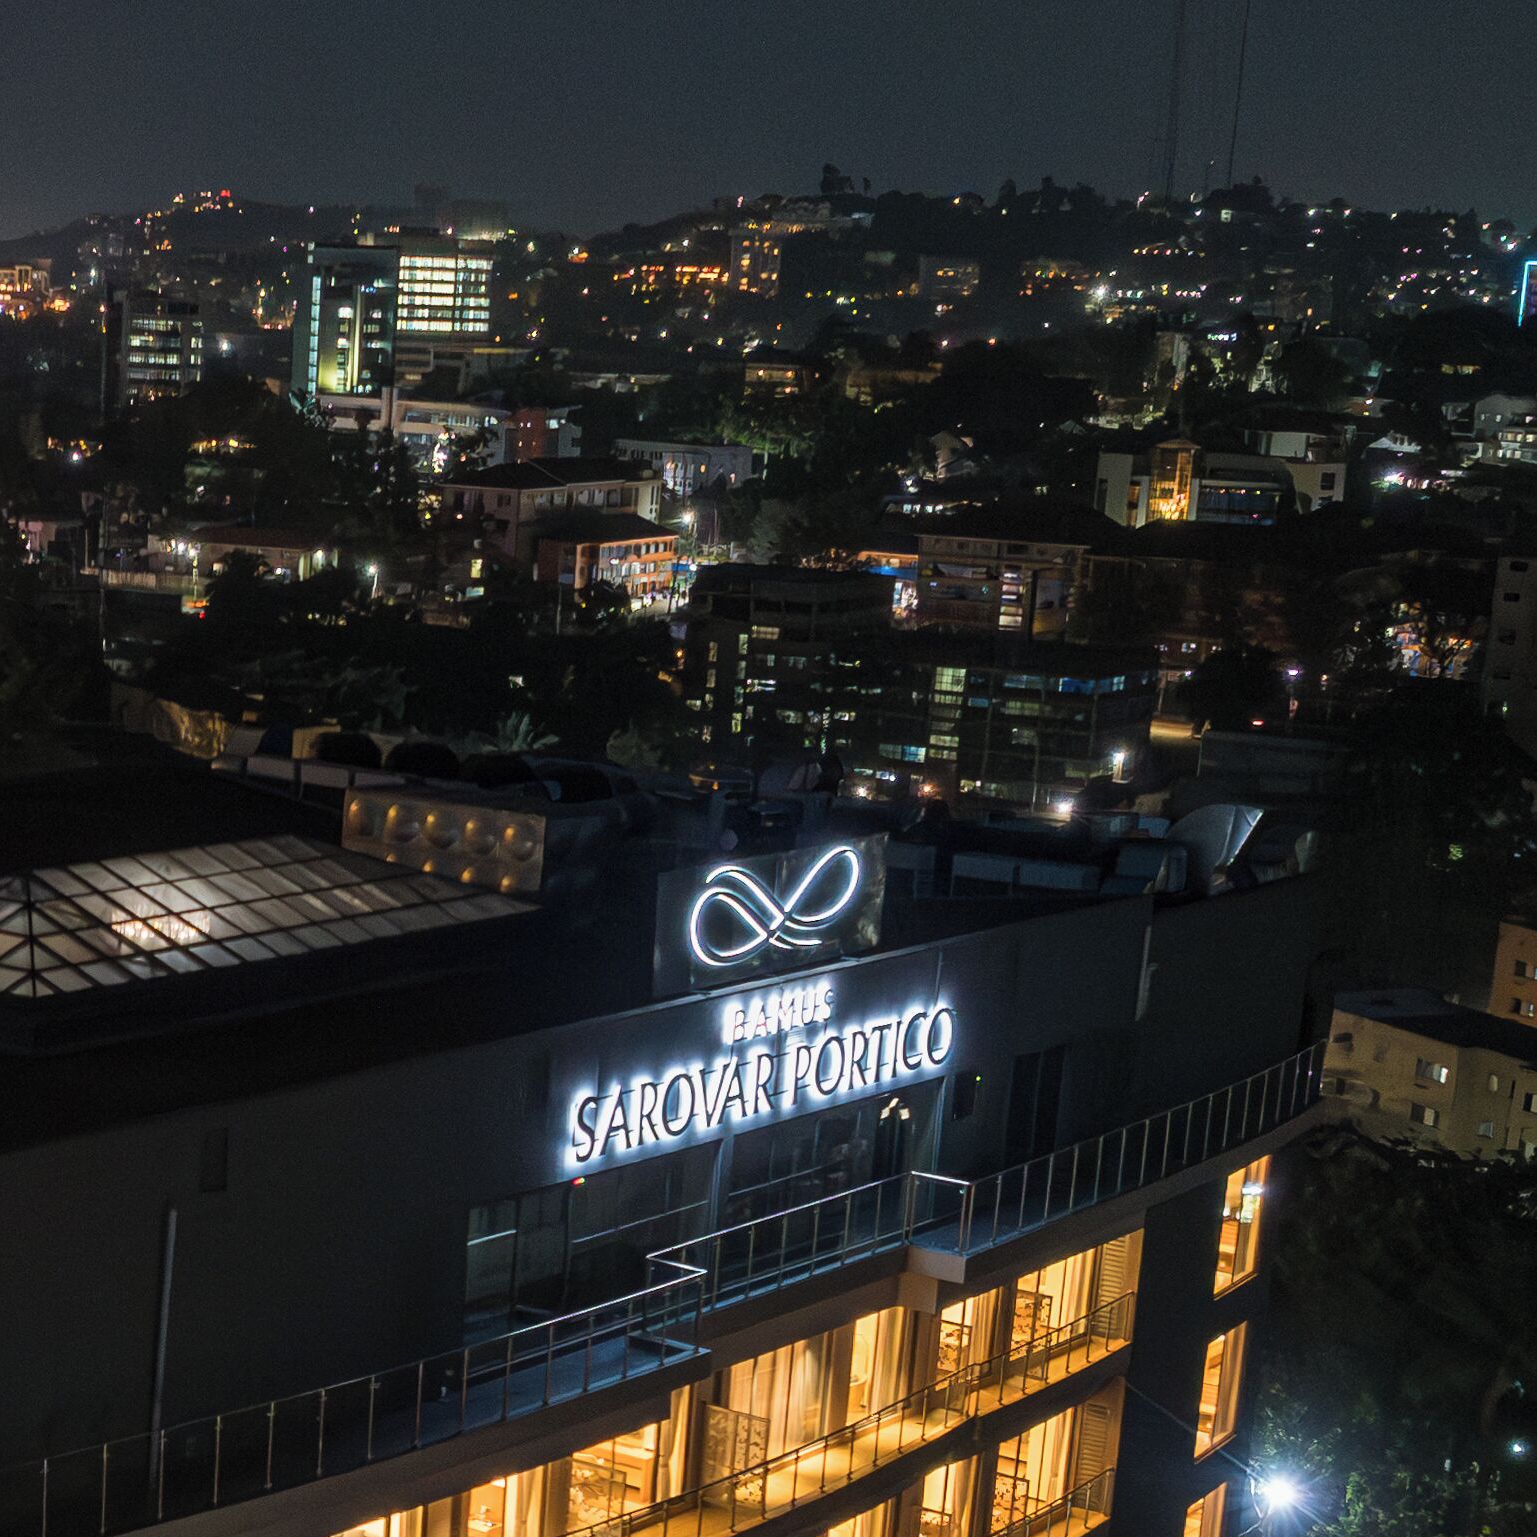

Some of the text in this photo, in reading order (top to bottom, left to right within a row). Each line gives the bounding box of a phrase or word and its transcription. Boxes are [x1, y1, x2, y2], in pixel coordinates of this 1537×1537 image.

[727, 988, 834, 1043] BAMUS
[573, 1006, 956, 1163] SAROVAR PORTICO
